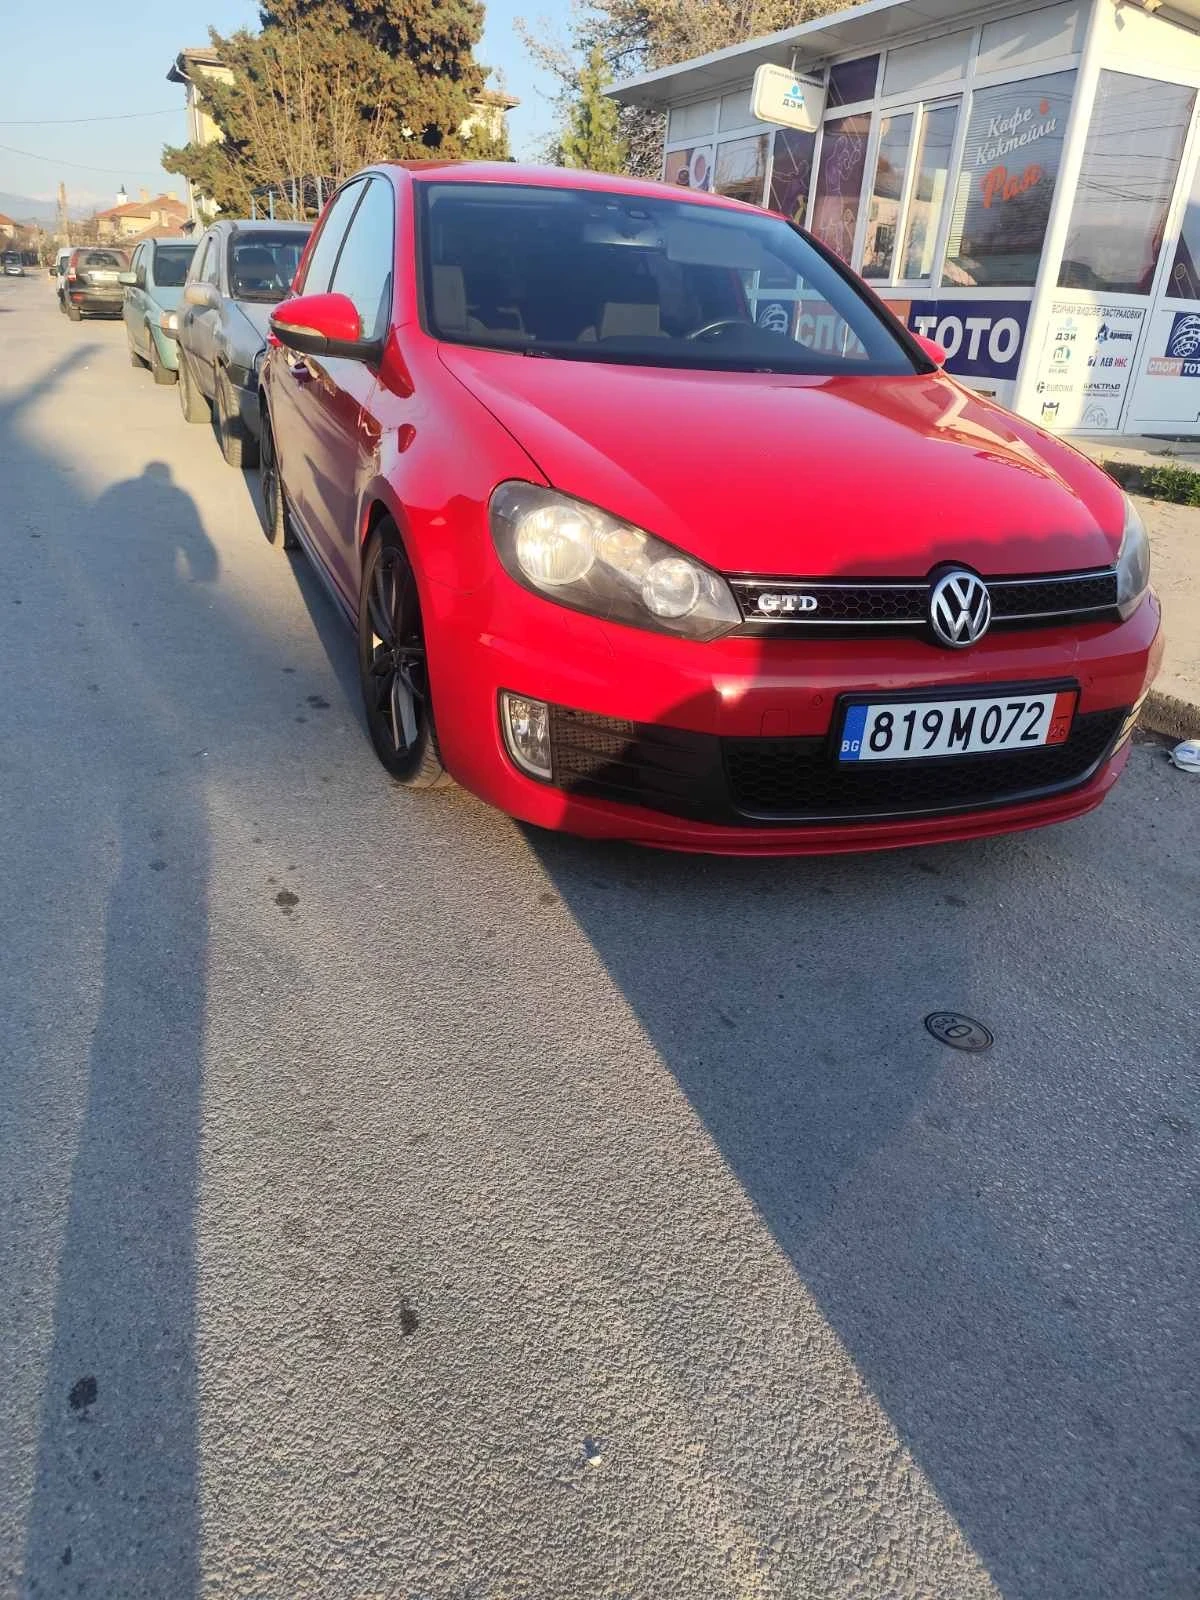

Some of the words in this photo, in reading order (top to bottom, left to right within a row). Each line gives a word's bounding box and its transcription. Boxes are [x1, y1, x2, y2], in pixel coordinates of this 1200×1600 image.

[988, 107, 1033, 138] Кафе
[976, 119, 1057, 165] Коктейли
[1102, 308, 1143, 320] ЗАСТРАХОВКИ
[914, 314, 1021, 364] ТОТО
[1055, 332, 1077, 341] ДЗИ
[1100, 356, 1114, 367] ЛЕВ
[1150, 360, 1183, 373] СПОРТ
[758, 593, 818, 611] GTD
[869, 701, 1045, 752] 819M072
[841, 740, 860, 752] BG
